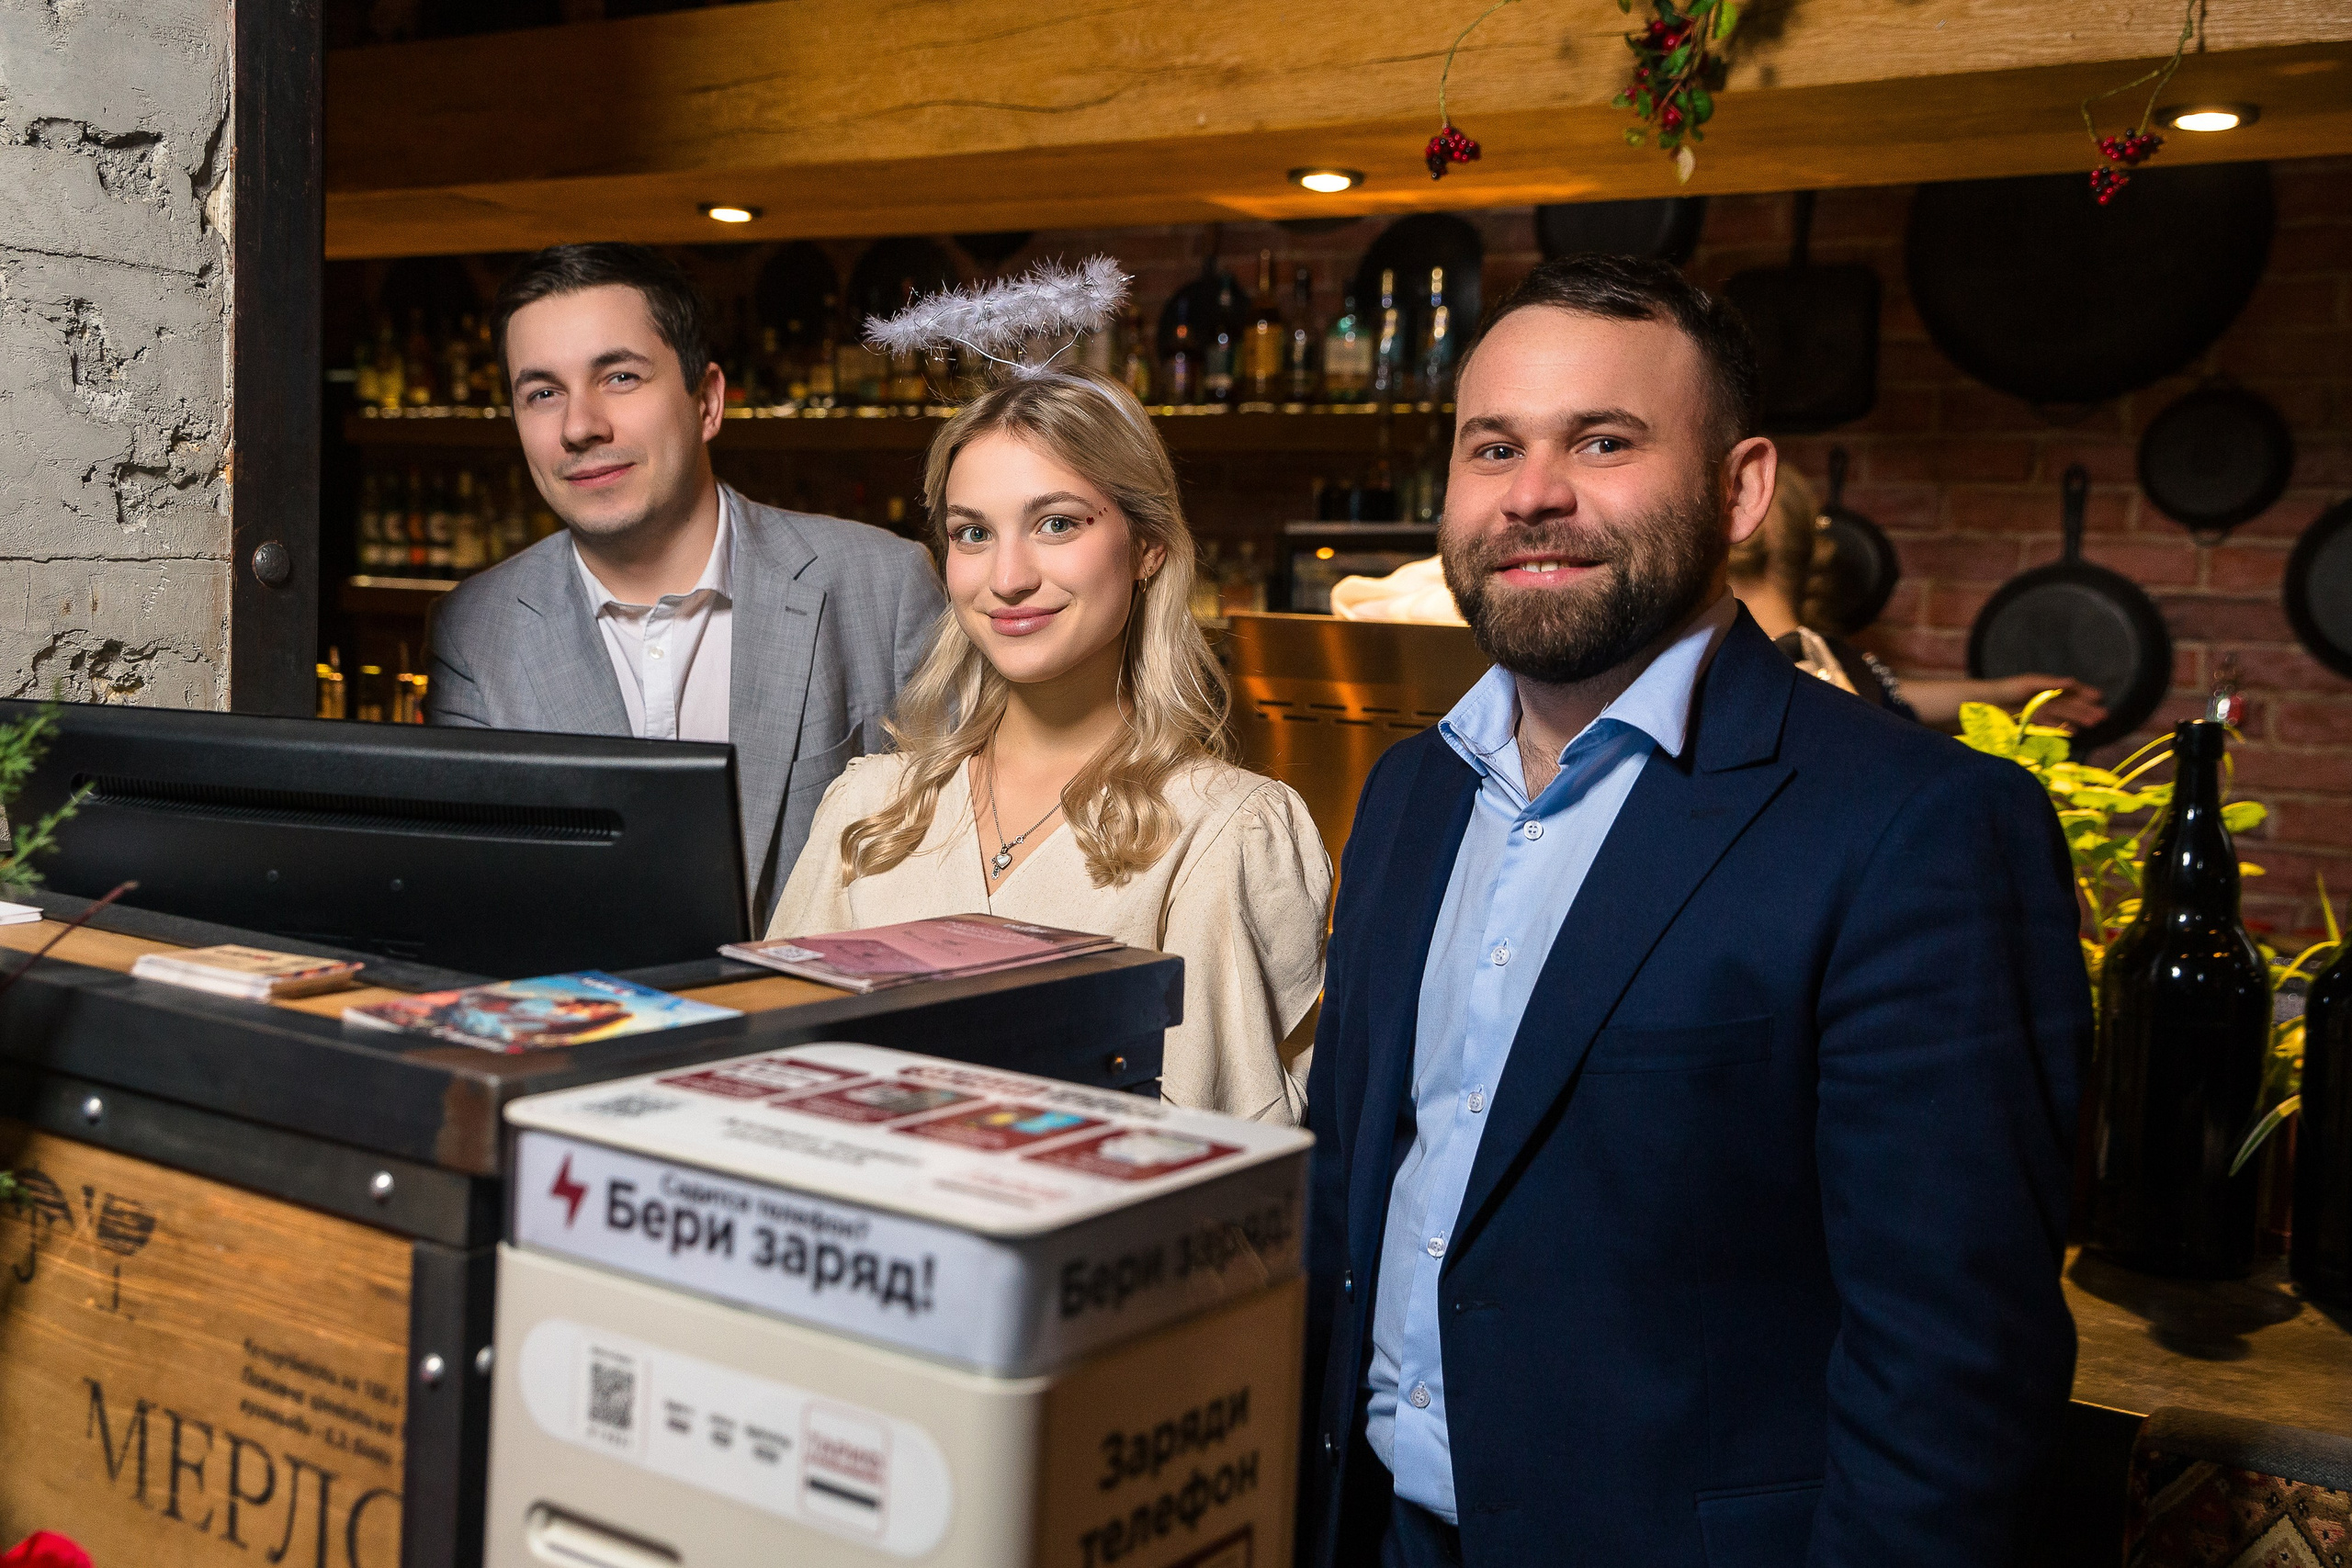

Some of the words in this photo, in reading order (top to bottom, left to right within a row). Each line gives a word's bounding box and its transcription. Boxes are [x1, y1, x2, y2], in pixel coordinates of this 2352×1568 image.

[606, 1178, 734, 1258] Бери
[753, 1226, 936, 1315] заряд!
[1060, 1247, 1163, 1320] Бери
[1099, 1387, 1250, 1492] Заряди
[1078, 1448, 1260, 1568] телефон
